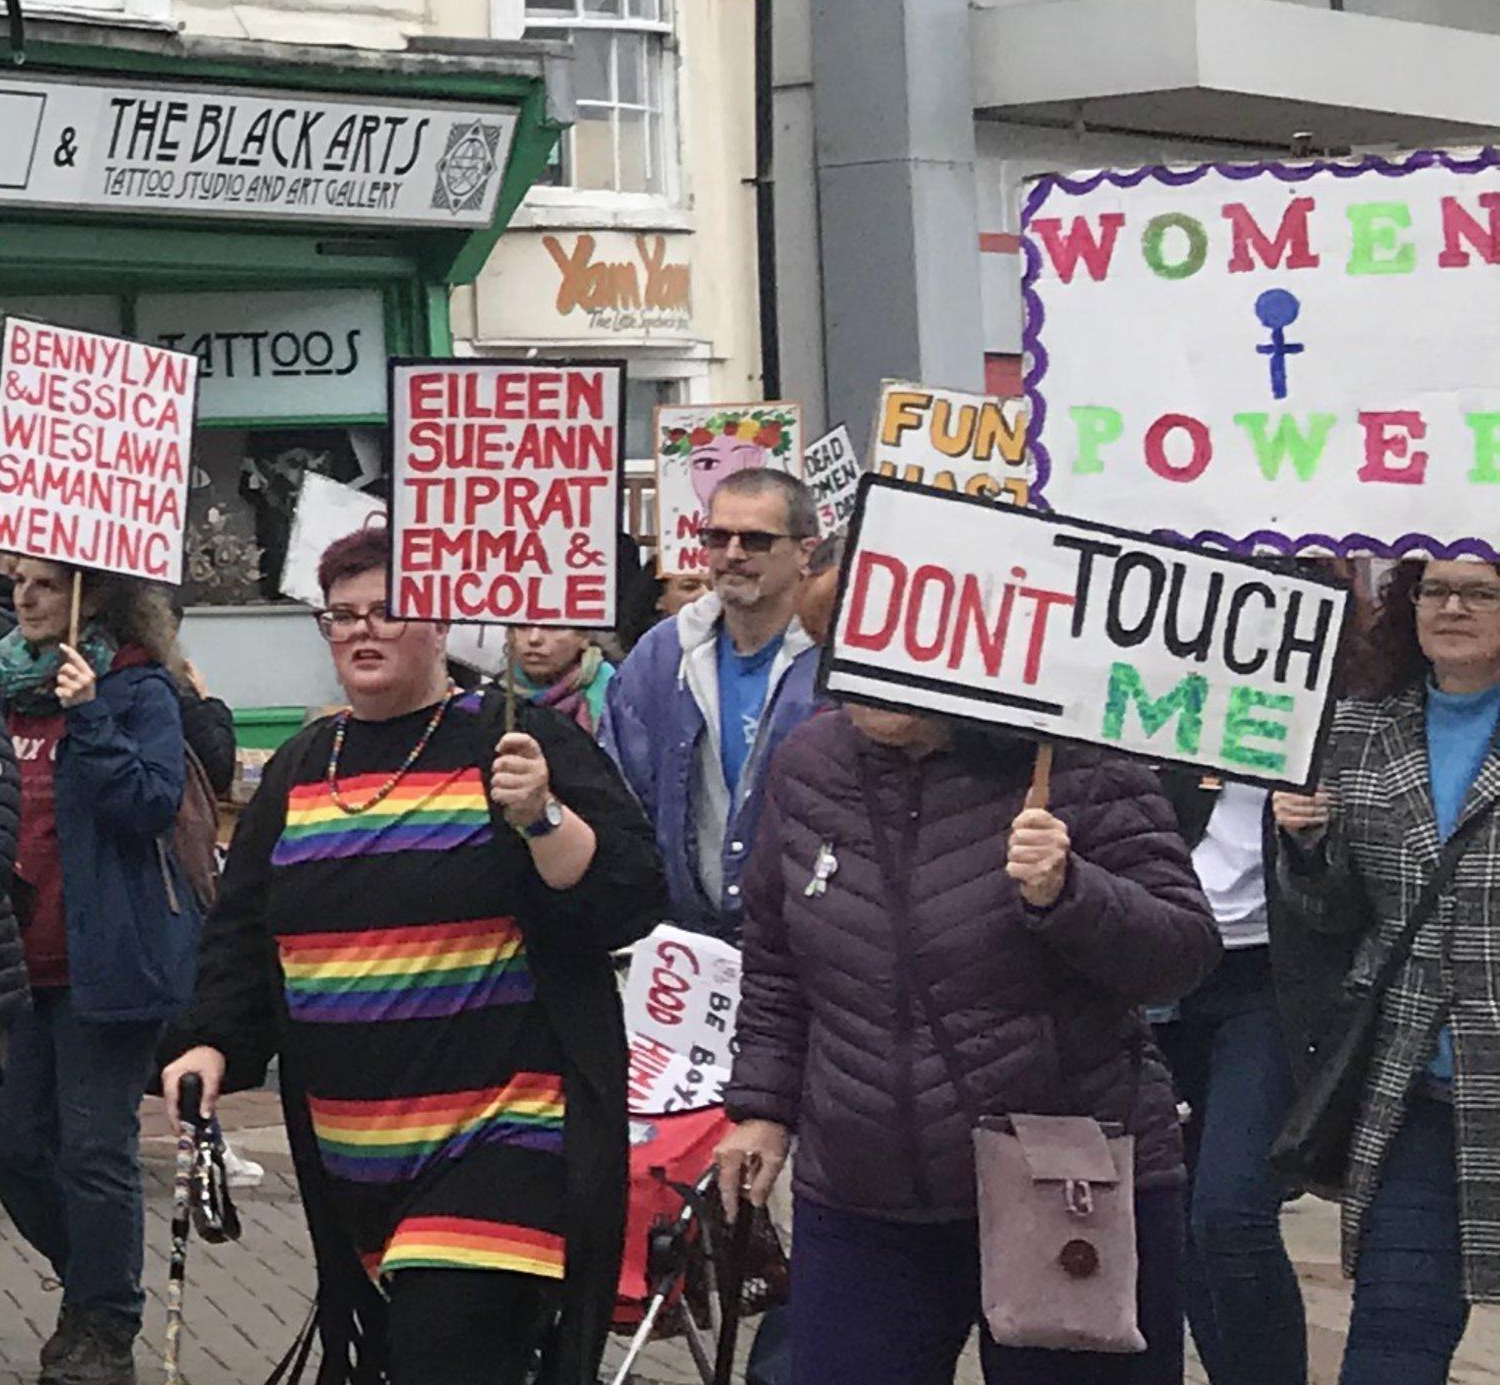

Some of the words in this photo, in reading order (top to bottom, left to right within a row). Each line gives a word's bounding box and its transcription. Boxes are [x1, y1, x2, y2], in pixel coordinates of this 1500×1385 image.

[53, 125, 79, 168] &
[107, 97, 189, 162] THE
[190, 104, 325, 170] BLACK
[322, 114, 431, 176] ARTS
[103, 166, 176, 199] TATTOO
[174, 170, 247, 202] STUDIO
[246, 174, 286, 203] AND
[285, 177, 325, 205] ART
[324, 179, 405, 210] GALLERY
[1031, 191, 1500, 285] WOMEN
[10, 325, 189, 395] BENNYLYN
[409, 372, 605, 420] EILEEN
[883, 391, 1028, 467] FUN
[2, 405, 184, 484] WIESLAWA
[804, 436, 845, 478] DEAD
[404, 476, 608, 530] TIPRAT
[401, 527, 553, 574] EMMA
[565, 532, 608, 569] &
[399, 573, 607, 621] NICOLE
[1053, 533, 1334, 691] TOUCH
[1100, 661, 1296, 773] ME
